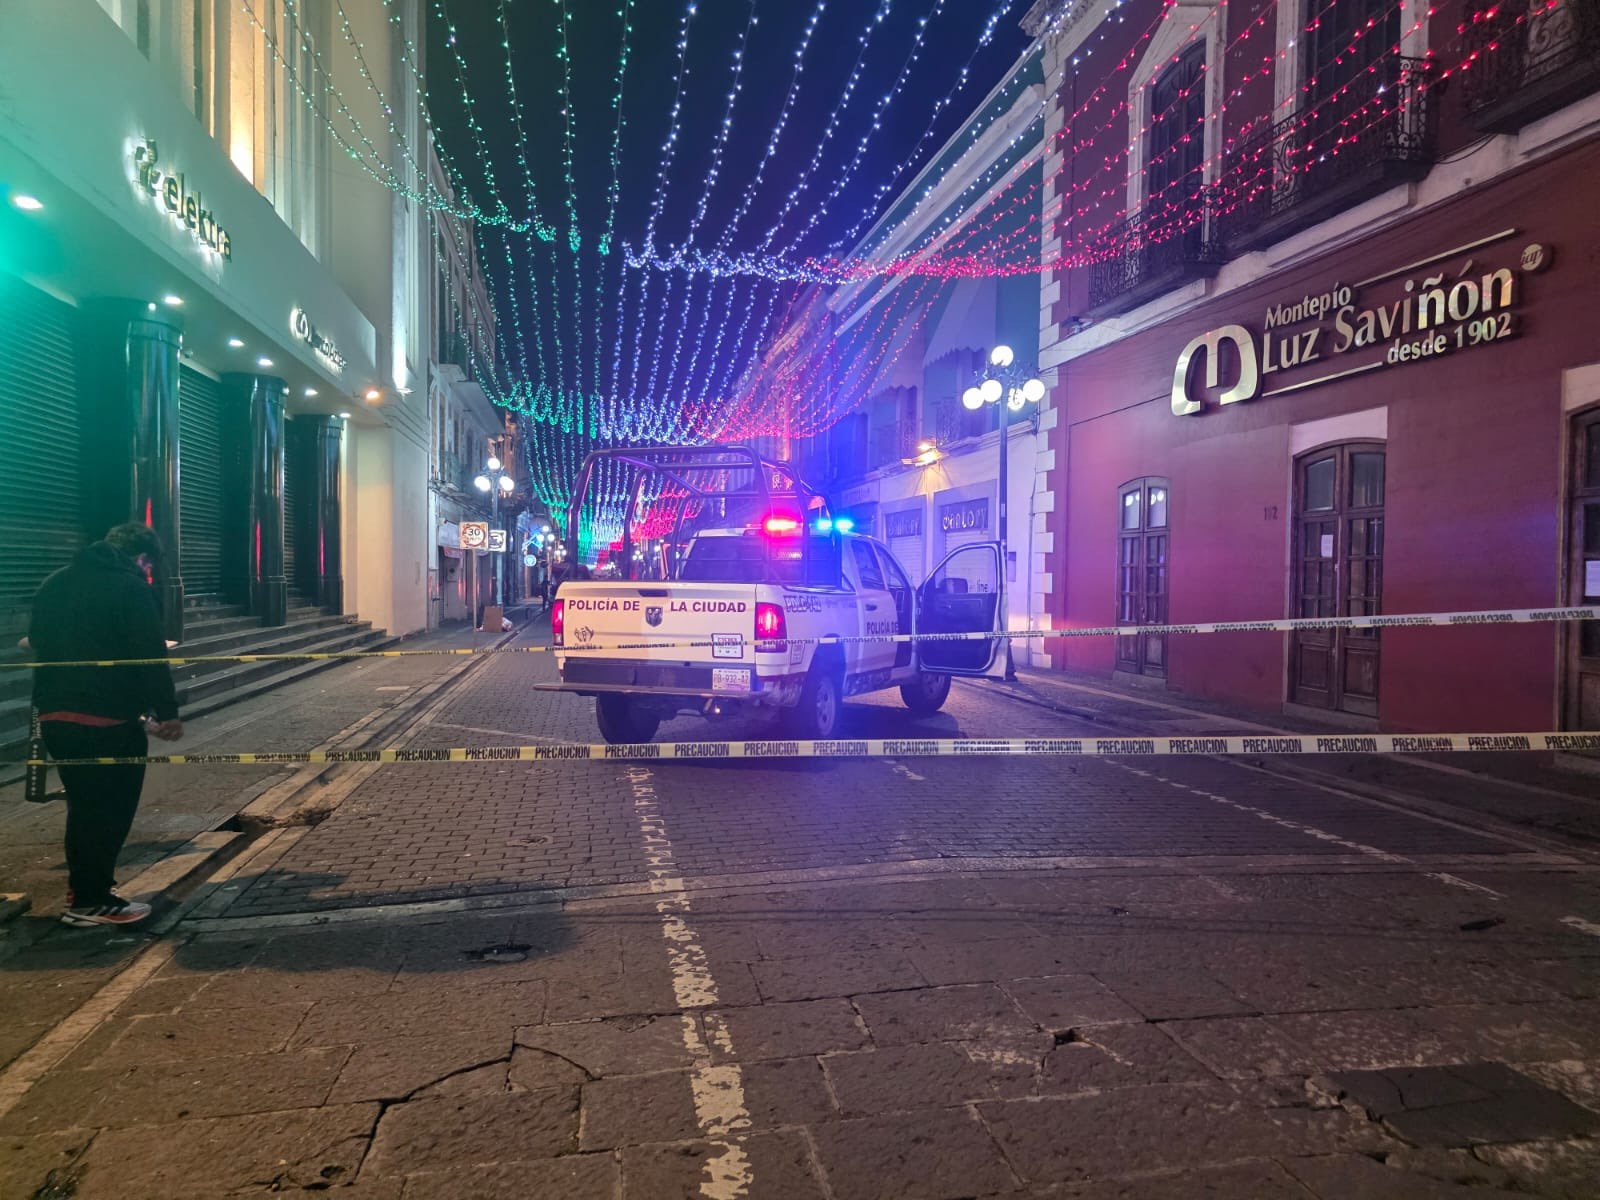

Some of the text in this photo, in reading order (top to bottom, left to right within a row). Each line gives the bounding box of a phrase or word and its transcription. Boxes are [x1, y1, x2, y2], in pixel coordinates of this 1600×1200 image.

[162, 172, 232, 263] elektra
[1262, 258, 1513, 374] Luz Saviñón
[1264, 282, 1351, 329] Montepío
[1387, 311, 1512, 364] desde 1902
[468, 528, 481, 536] 30
[568, 597, 747, 613] POLICÍA DE LA CIUDAD
[394, 749, 451, 761] PRECAUCION
[465, 747, 521, 760] PRECAUCION
[535, 746, 591, 760] PRECAUCION
[605, 744, 660, 758] PRECAUCION
[674, 743, 729, 757] PRECAUCION
[744, 742, 799, 756] PRECAUCION
[813, 741, 869, 755] PRECAUCION
[883, 741, 939, 755] PRECAUCION
[1096, 739, 1154, 754] PRECAUCION
[1169, 738, 1228, 753] PRECAUCION
[1242, 738, 1302, 753] PRECAUCION
[1317, 737, 1377, 752] PRECAUCION
[1392, 737, 1453, 751] PRECAUCION
[1468, 735, 1530, 751] PRECAUCION
